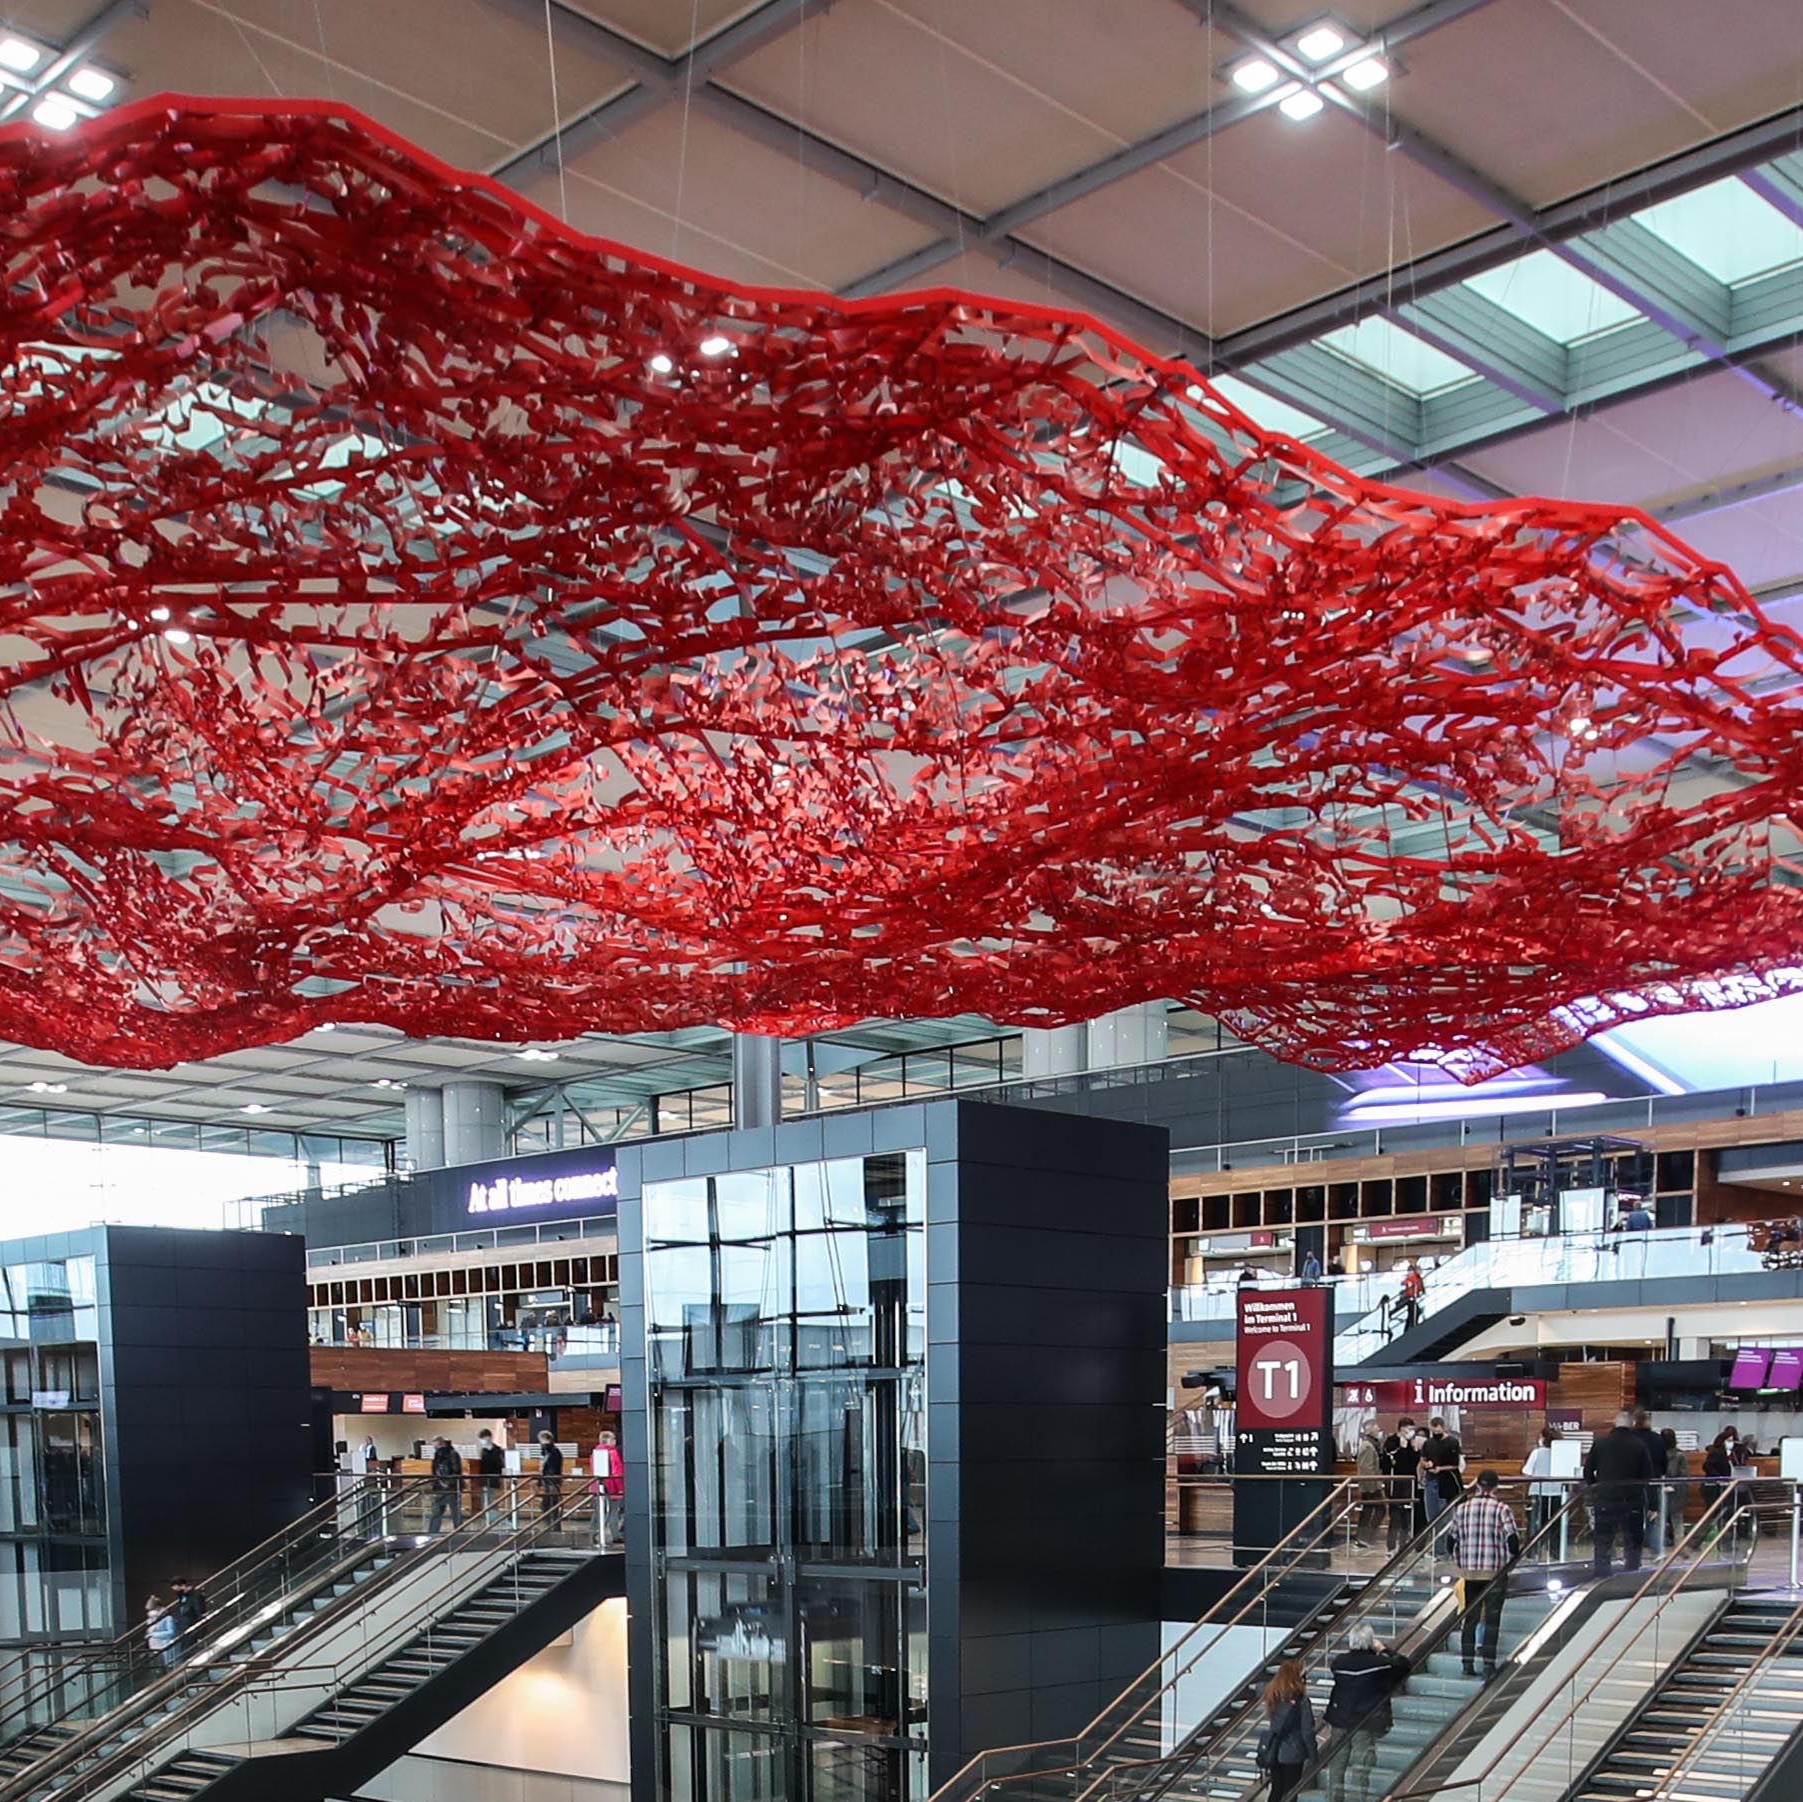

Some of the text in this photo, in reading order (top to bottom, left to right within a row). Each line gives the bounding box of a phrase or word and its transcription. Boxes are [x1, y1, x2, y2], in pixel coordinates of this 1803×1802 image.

[1256, 1313, 1291, 1323] Terminal
[1257, 1360, 1298, 1399] T1
[1429, 1381, 1536, 1404] Information
